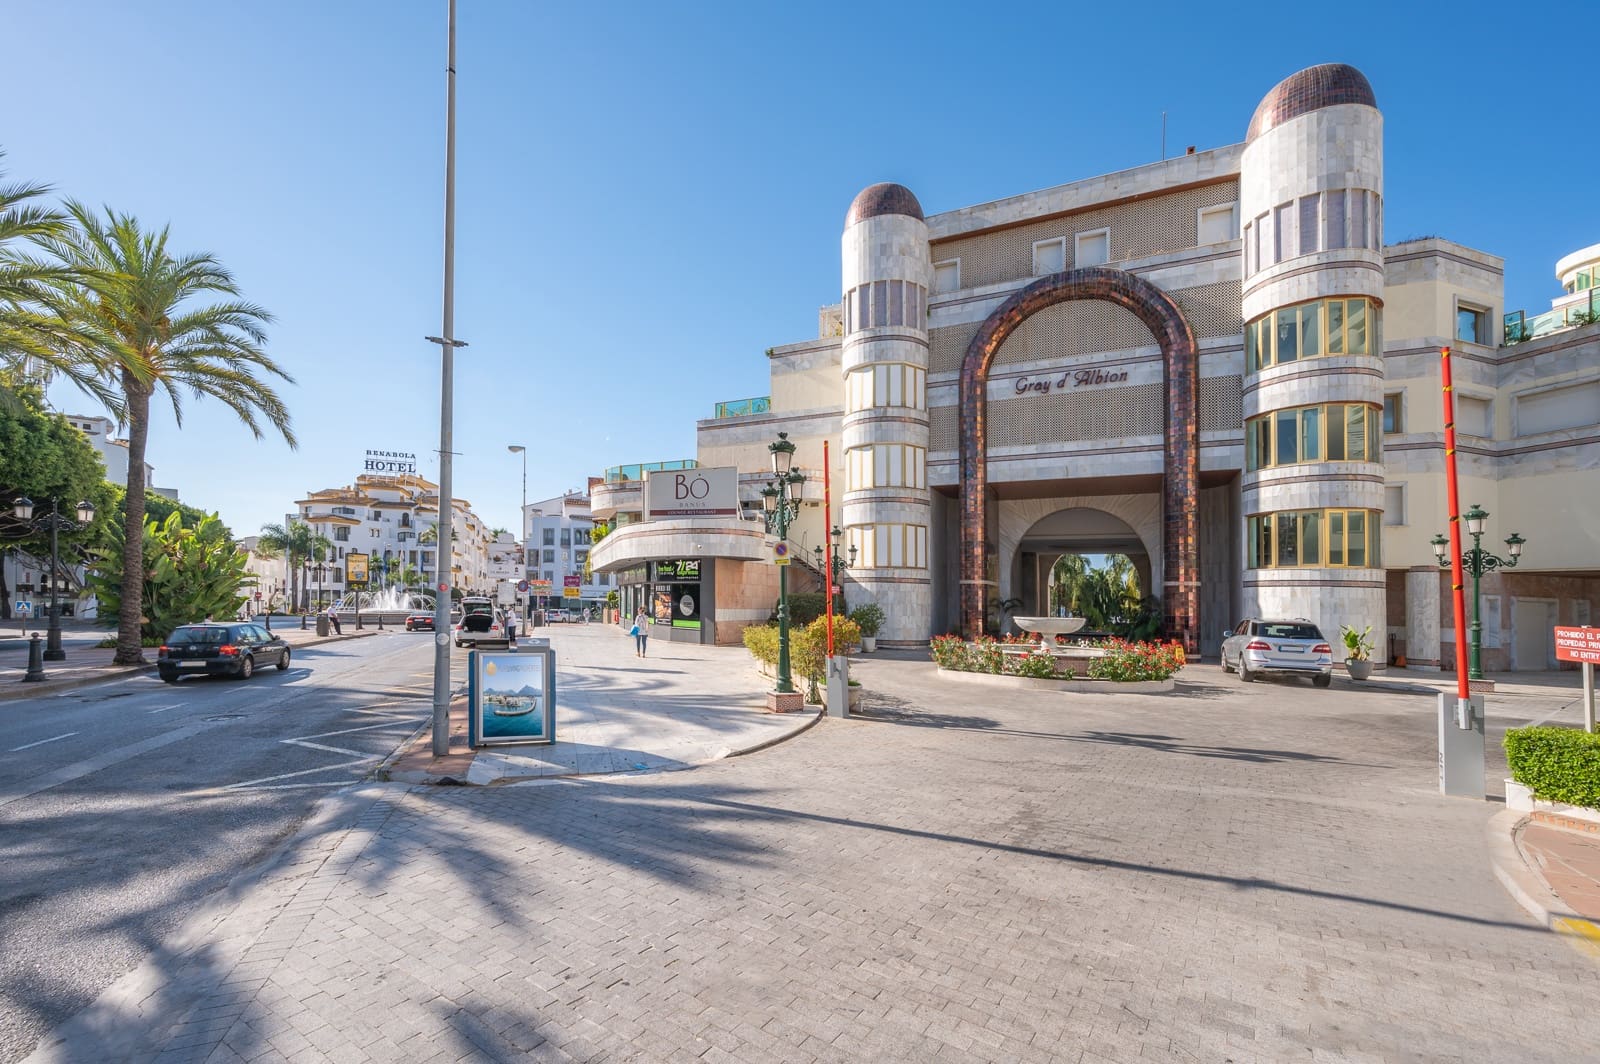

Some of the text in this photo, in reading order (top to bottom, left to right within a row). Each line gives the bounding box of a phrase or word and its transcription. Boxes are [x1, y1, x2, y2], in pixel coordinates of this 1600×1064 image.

[1015, 377, 1052, 395] Gray
[1074, 369, 1128, 387] Albion
[366, 450, 416, 459] BENABOLA
[365, 460, 416, 472] HOTEL
[1557, 630, 1584, 638] PROHIBIDO
[1580, 652, 1600, 660] ENTRY
